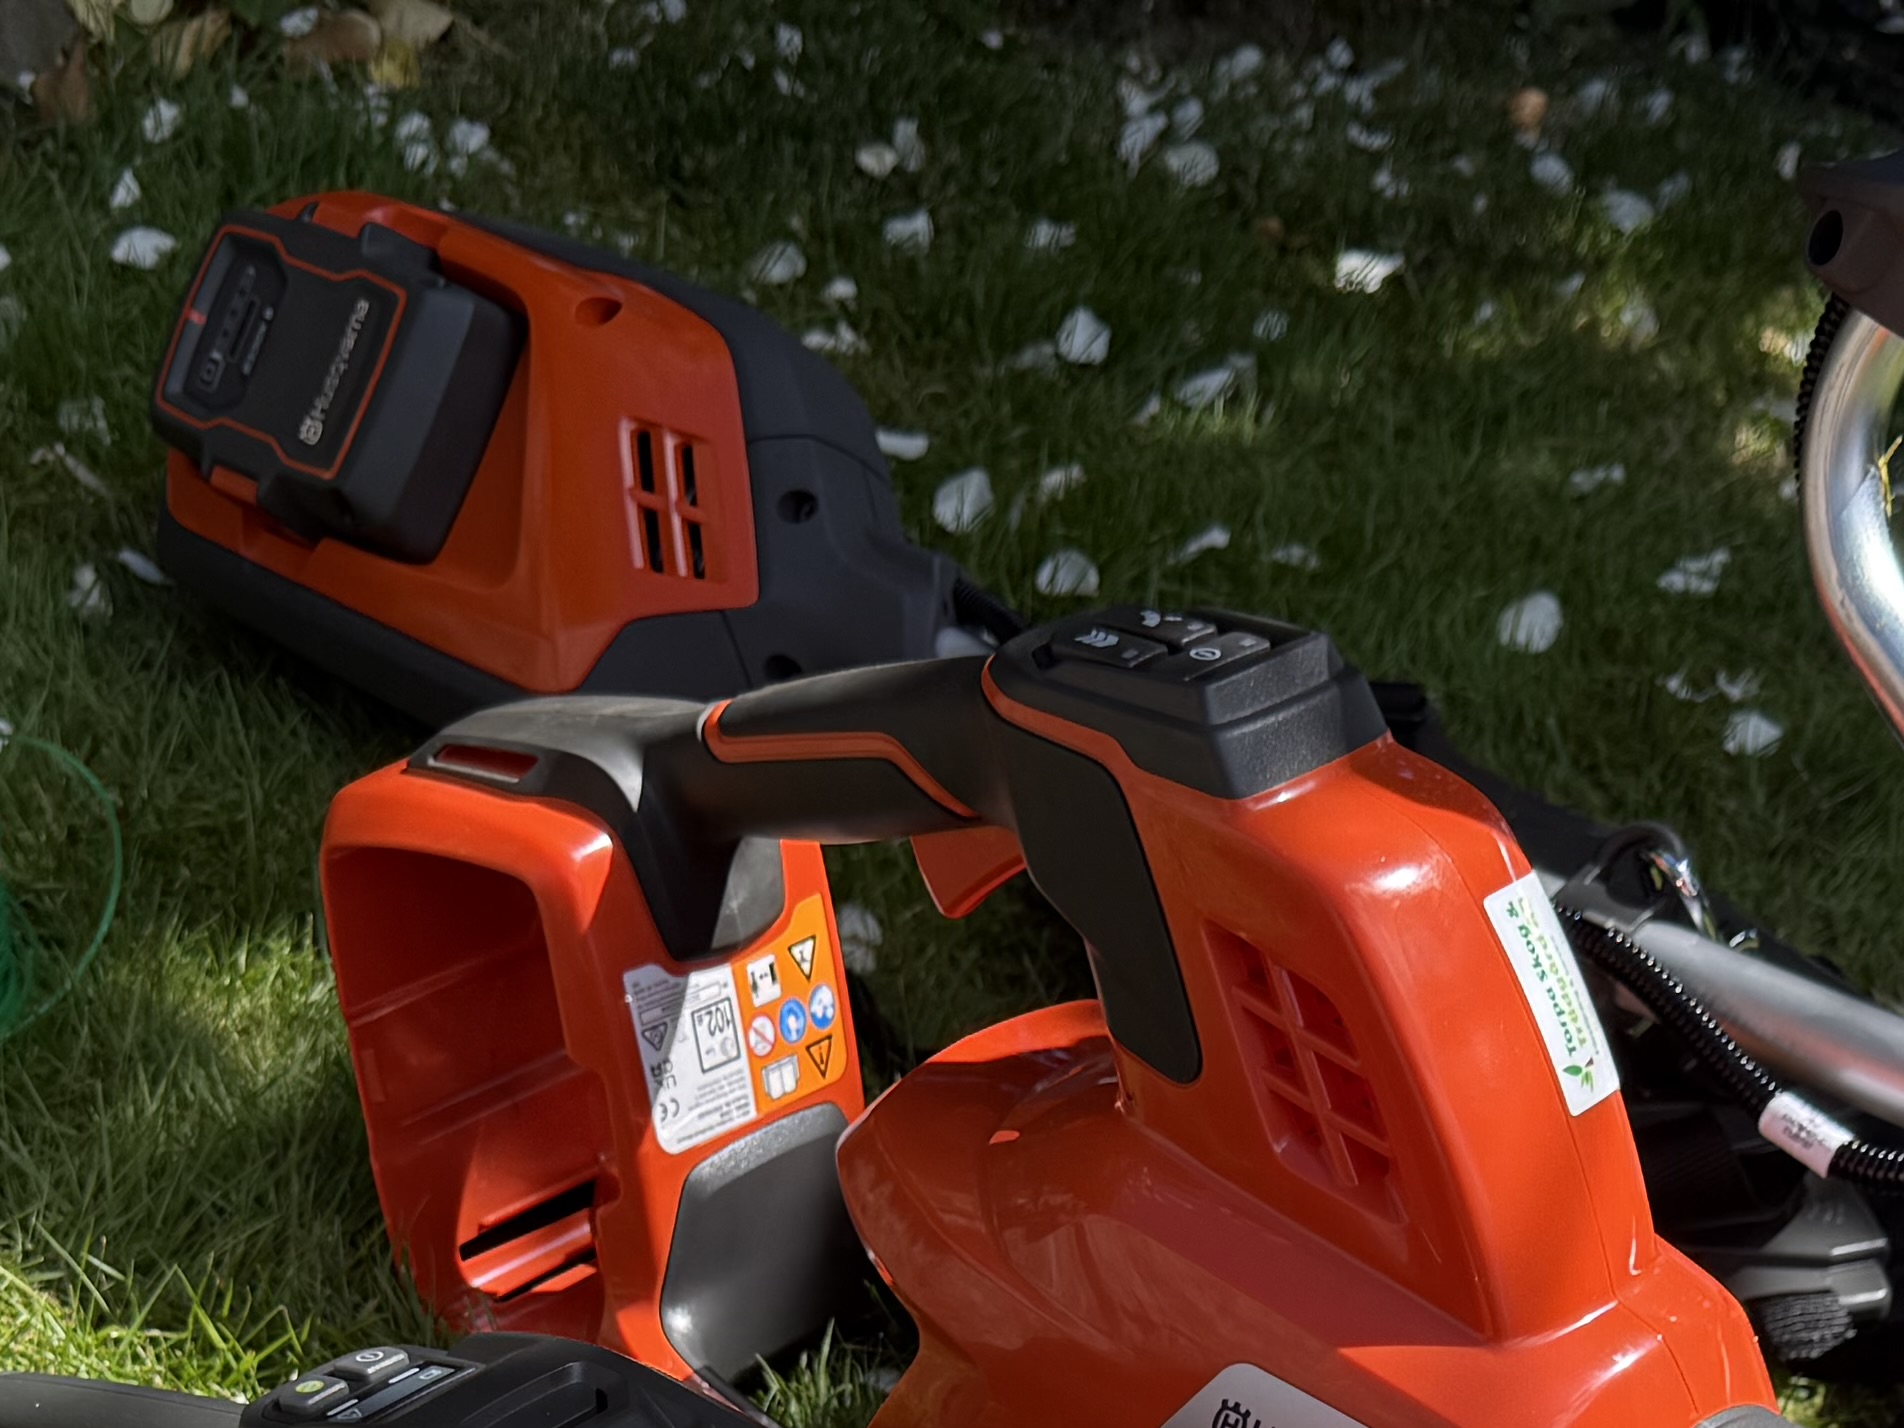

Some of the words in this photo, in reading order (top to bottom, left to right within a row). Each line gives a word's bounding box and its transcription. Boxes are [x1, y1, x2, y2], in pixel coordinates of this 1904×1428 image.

[1518, 924, 1548, 983] Skog
[708, 1004, 732, 1037] 102
[1546, 987, 1577, 1057] Torpa
